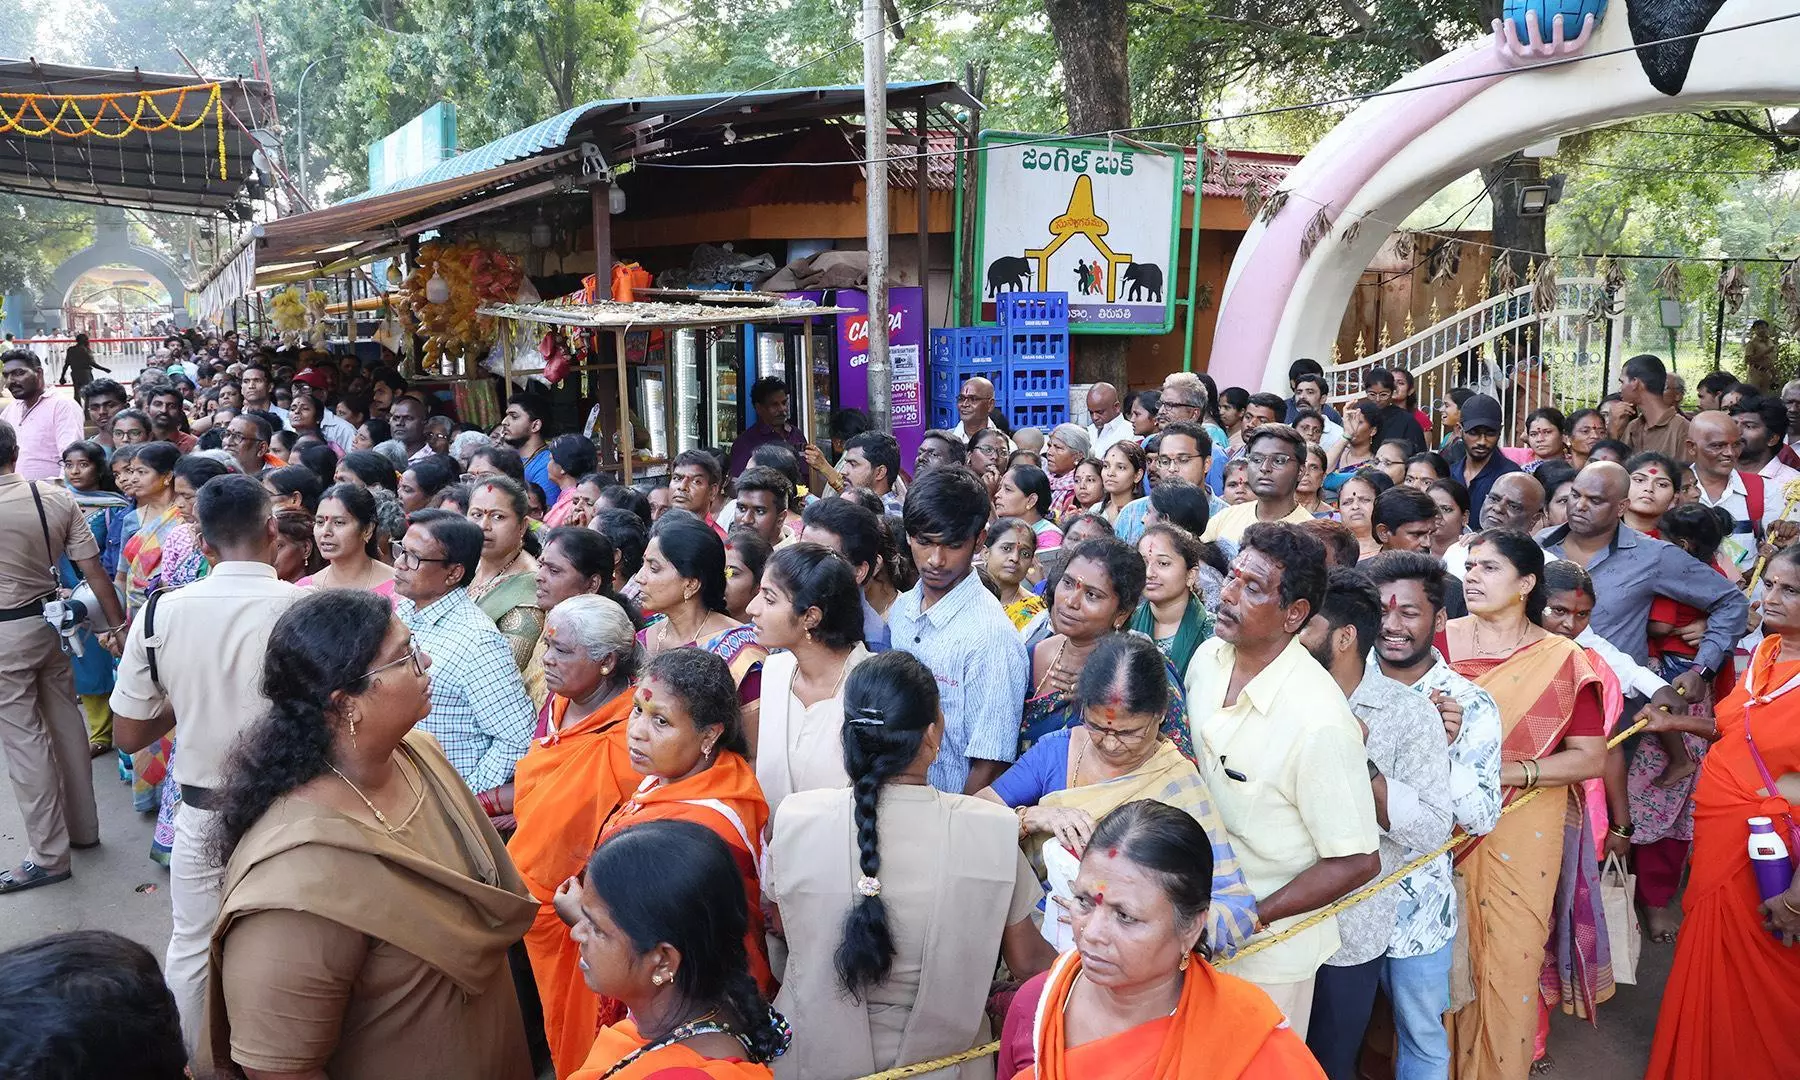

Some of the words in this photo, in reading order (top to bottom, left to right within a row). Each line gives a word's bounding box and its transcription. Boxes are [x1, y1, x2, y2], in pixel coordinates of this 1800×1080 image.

[1022, 148, 1091, 173] జంగిల్
[1095, 152, 1134, 176] బుక్
[849, 312, 902, 341] CAPA
[1098, 308, 1131, 319] తిరుపతి
